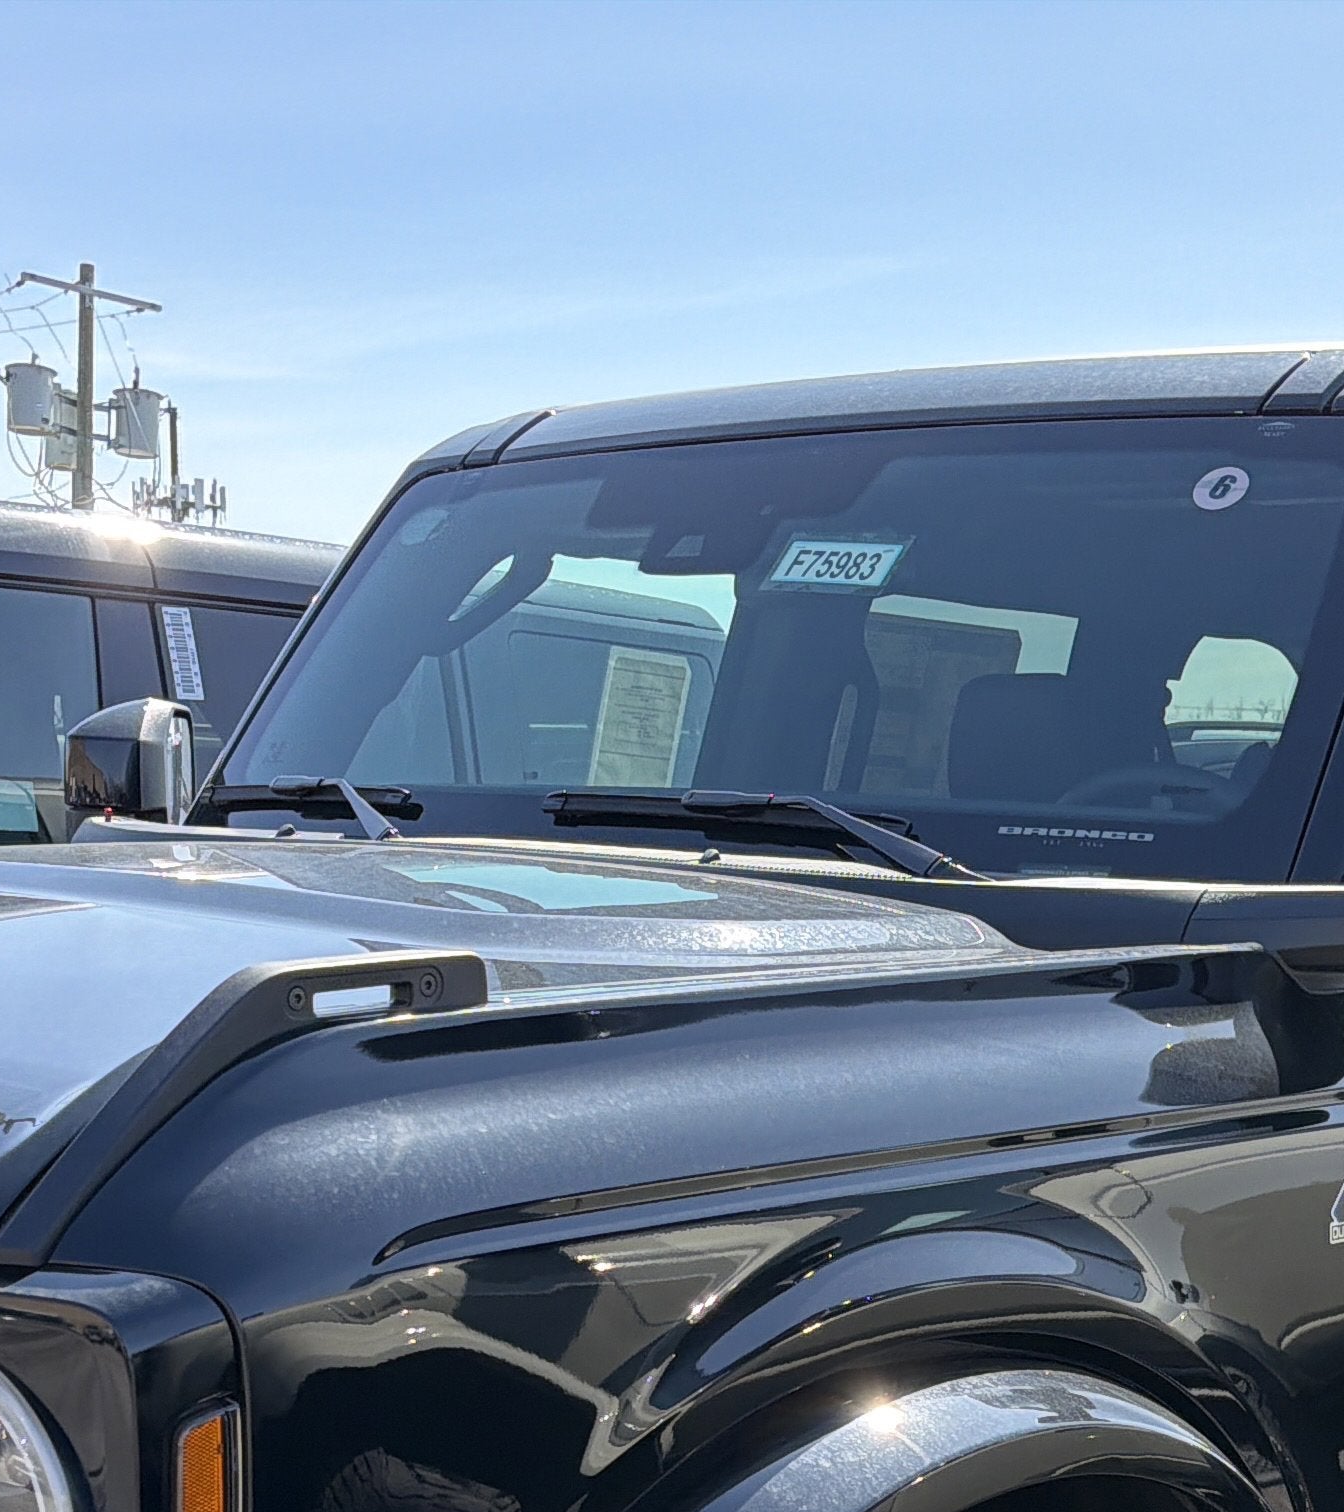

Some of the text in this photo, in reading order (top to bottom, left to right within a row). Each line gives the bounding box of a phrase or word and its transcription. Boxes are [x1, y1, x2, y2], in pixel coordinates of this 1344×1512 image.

[1208, 474, 1238, 500] 6
[784, 549, 882, 581] F75983
[997, 826, 1155, 842] BRONCO
